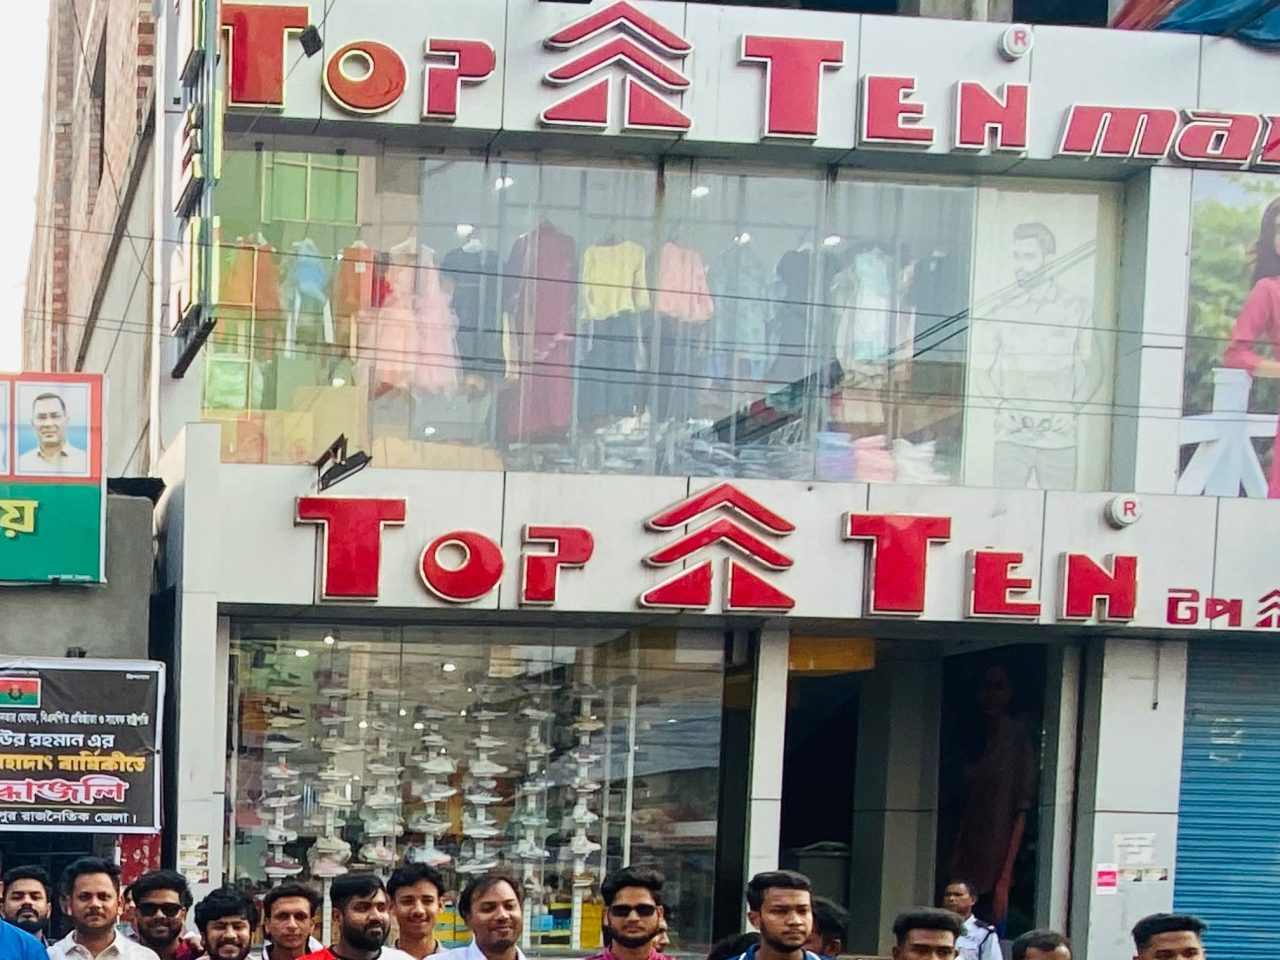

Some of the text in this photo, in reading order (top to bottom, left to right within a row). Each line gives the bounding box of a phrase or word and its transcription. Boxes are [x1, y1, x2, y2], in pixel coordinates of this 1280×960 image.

[29, 734, 84, 748] রহমান
[87, 735, 115, 749] এর
[58, 748, 146, 772] বার্ষিকীতে
[20, 809, 90, 822] রাজনৈতিক
